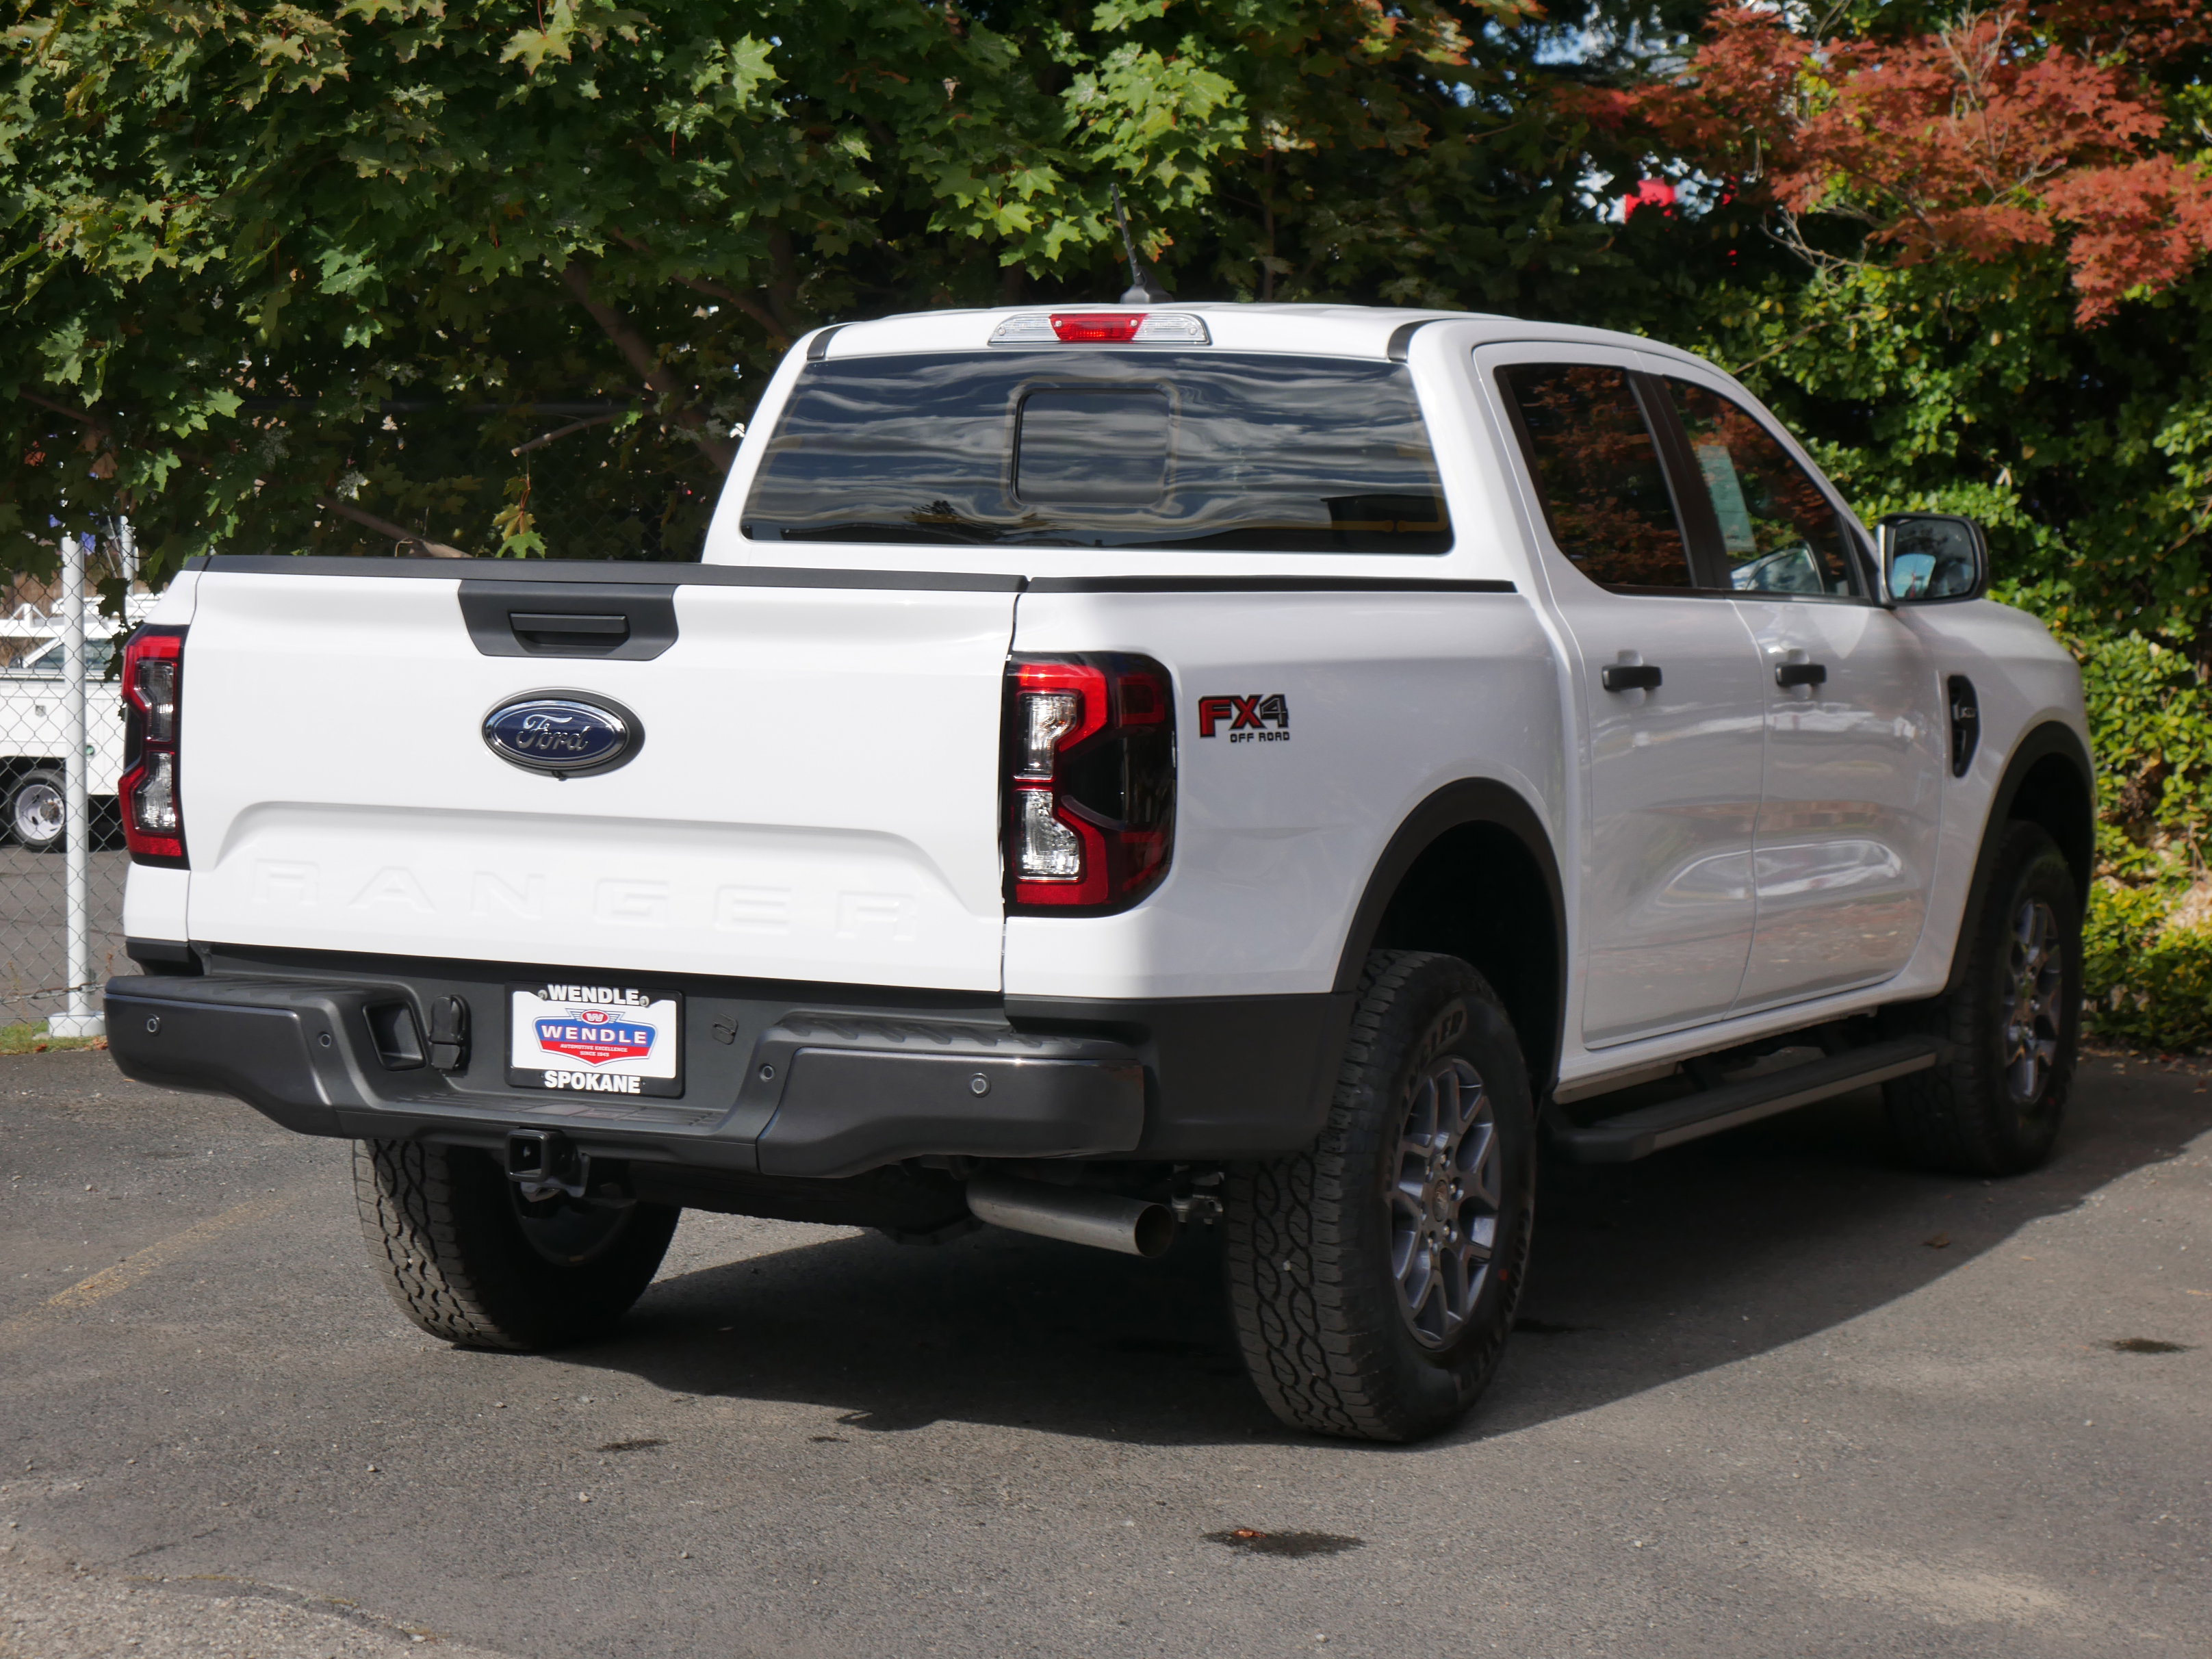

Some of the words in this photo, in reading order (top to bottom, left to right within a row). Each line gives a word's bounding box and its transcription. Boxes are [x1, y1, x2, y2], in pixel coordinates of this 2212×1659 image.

[1198, 694, 1289, 737] FX4
[515, 714, 590, 751] Ford
[1230, 733, 1254, 743] OFF
[1259, 732, 1289, 741] ROAD
[249, 857, 918, 942] RANGER
[548, 983, 639, 1005] WENDLE
[541, 1025, 647, 1044] WENDLE
[544, 1070, 641, 1093] SPOKANE
